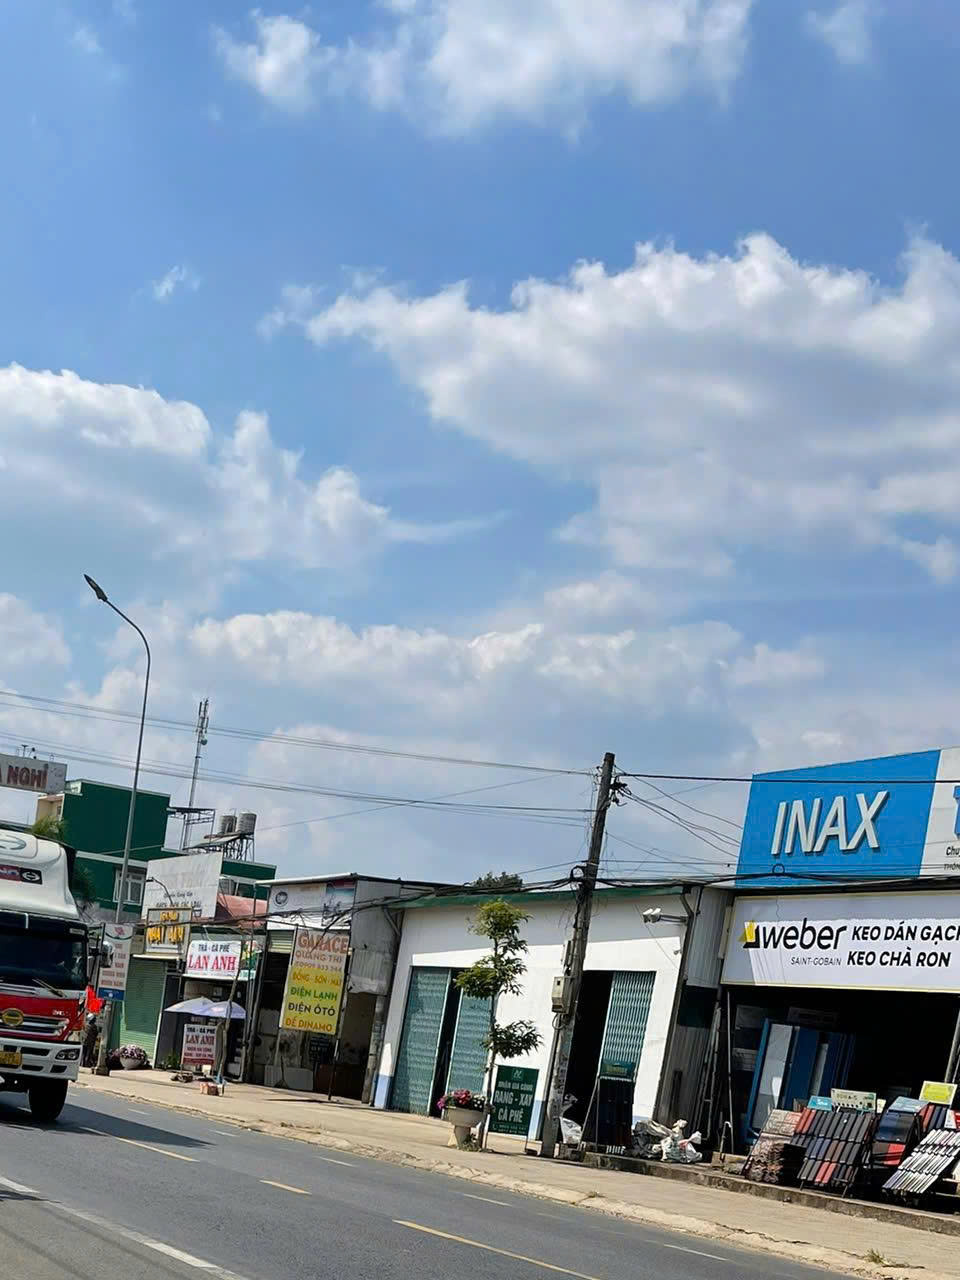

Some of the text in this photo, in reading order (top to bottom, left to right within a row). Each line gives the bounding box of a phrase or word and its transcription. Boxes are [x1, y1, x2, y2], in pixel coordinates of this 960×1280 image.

[770, 789, 890, 856] INAX
[946, 846, 960, 857] Chu
[761, 917, 847, 950] weber
[851, 925, 881, 941] KEO
[883, 921, 917, 941] DÁN
[188, 954, 237, 971] LAN ANH
[790, 956, 842, 967] SAINT-GOBAIN
[847, 946, 952, 967] KEO CHÀ RON
[290, 985, 339, 1002] ĐIỆN LẠNH
[288, 1001, 312, 1015] ĐIỆN
[185, 1034, 215, 1046] LAN ANH
[494, 1090, 514, 1105] RANG
[518, 1093, 534, 1107] XAY
[508, 1107, 525, 1123] PHÊ
